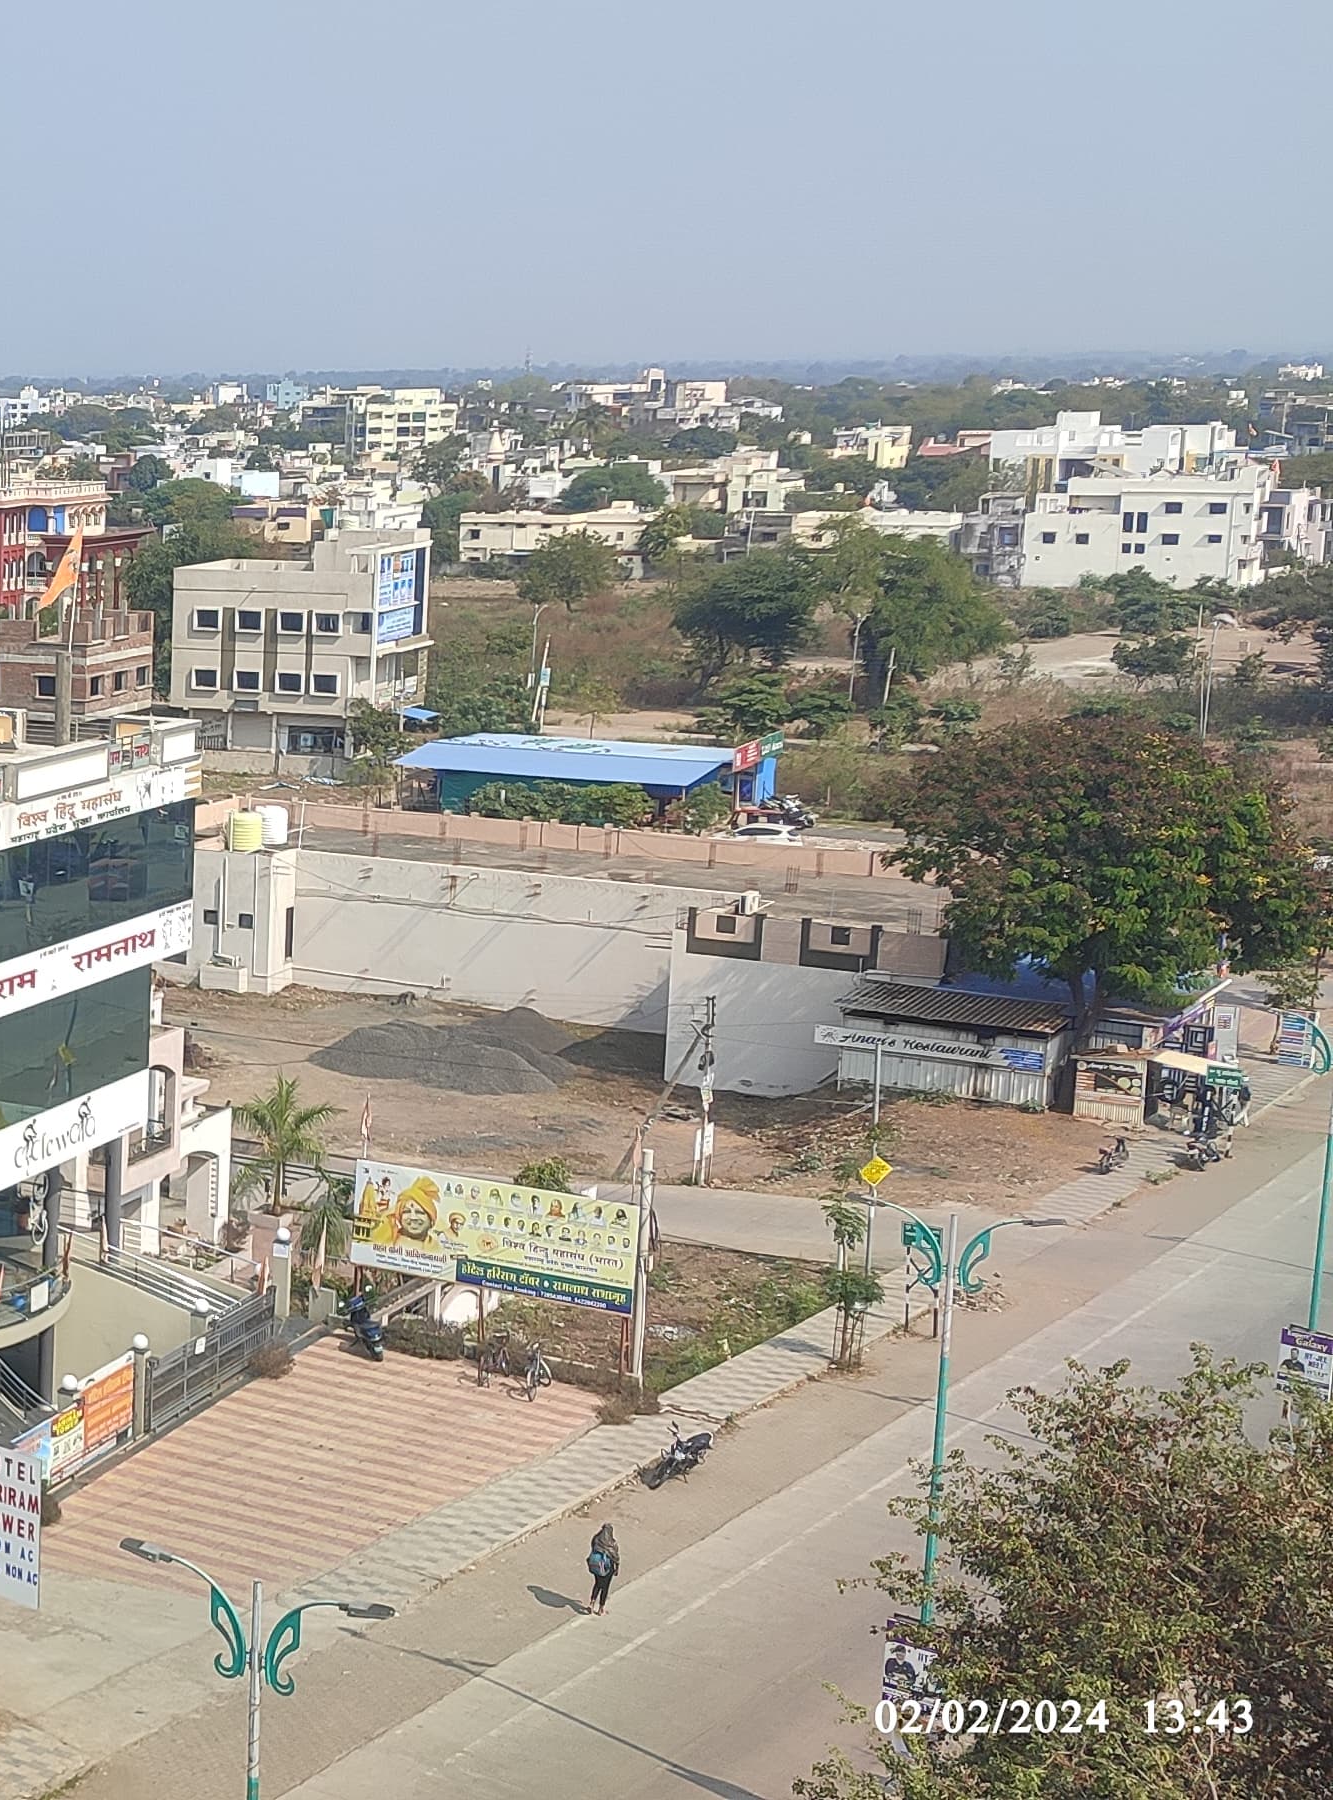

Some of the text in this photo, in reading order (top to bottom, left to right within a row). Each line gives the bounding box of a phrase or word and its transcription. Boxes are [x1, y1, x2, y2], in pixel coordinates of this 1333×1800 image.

[81, 787, 123, 811] महासंघ
[71, 928, 156, 972] रामनाथ
[903, 1039, 993, 1058] Restaurant
[589, 1253, 624, 1270] (भारत)
[1295, 1336, 1328, 1353] Galaxy
[20, 1547, 34, 1563] AC
[5, 1563, 23, 1581] NON
[26, 1571, 38, 1586] AC
